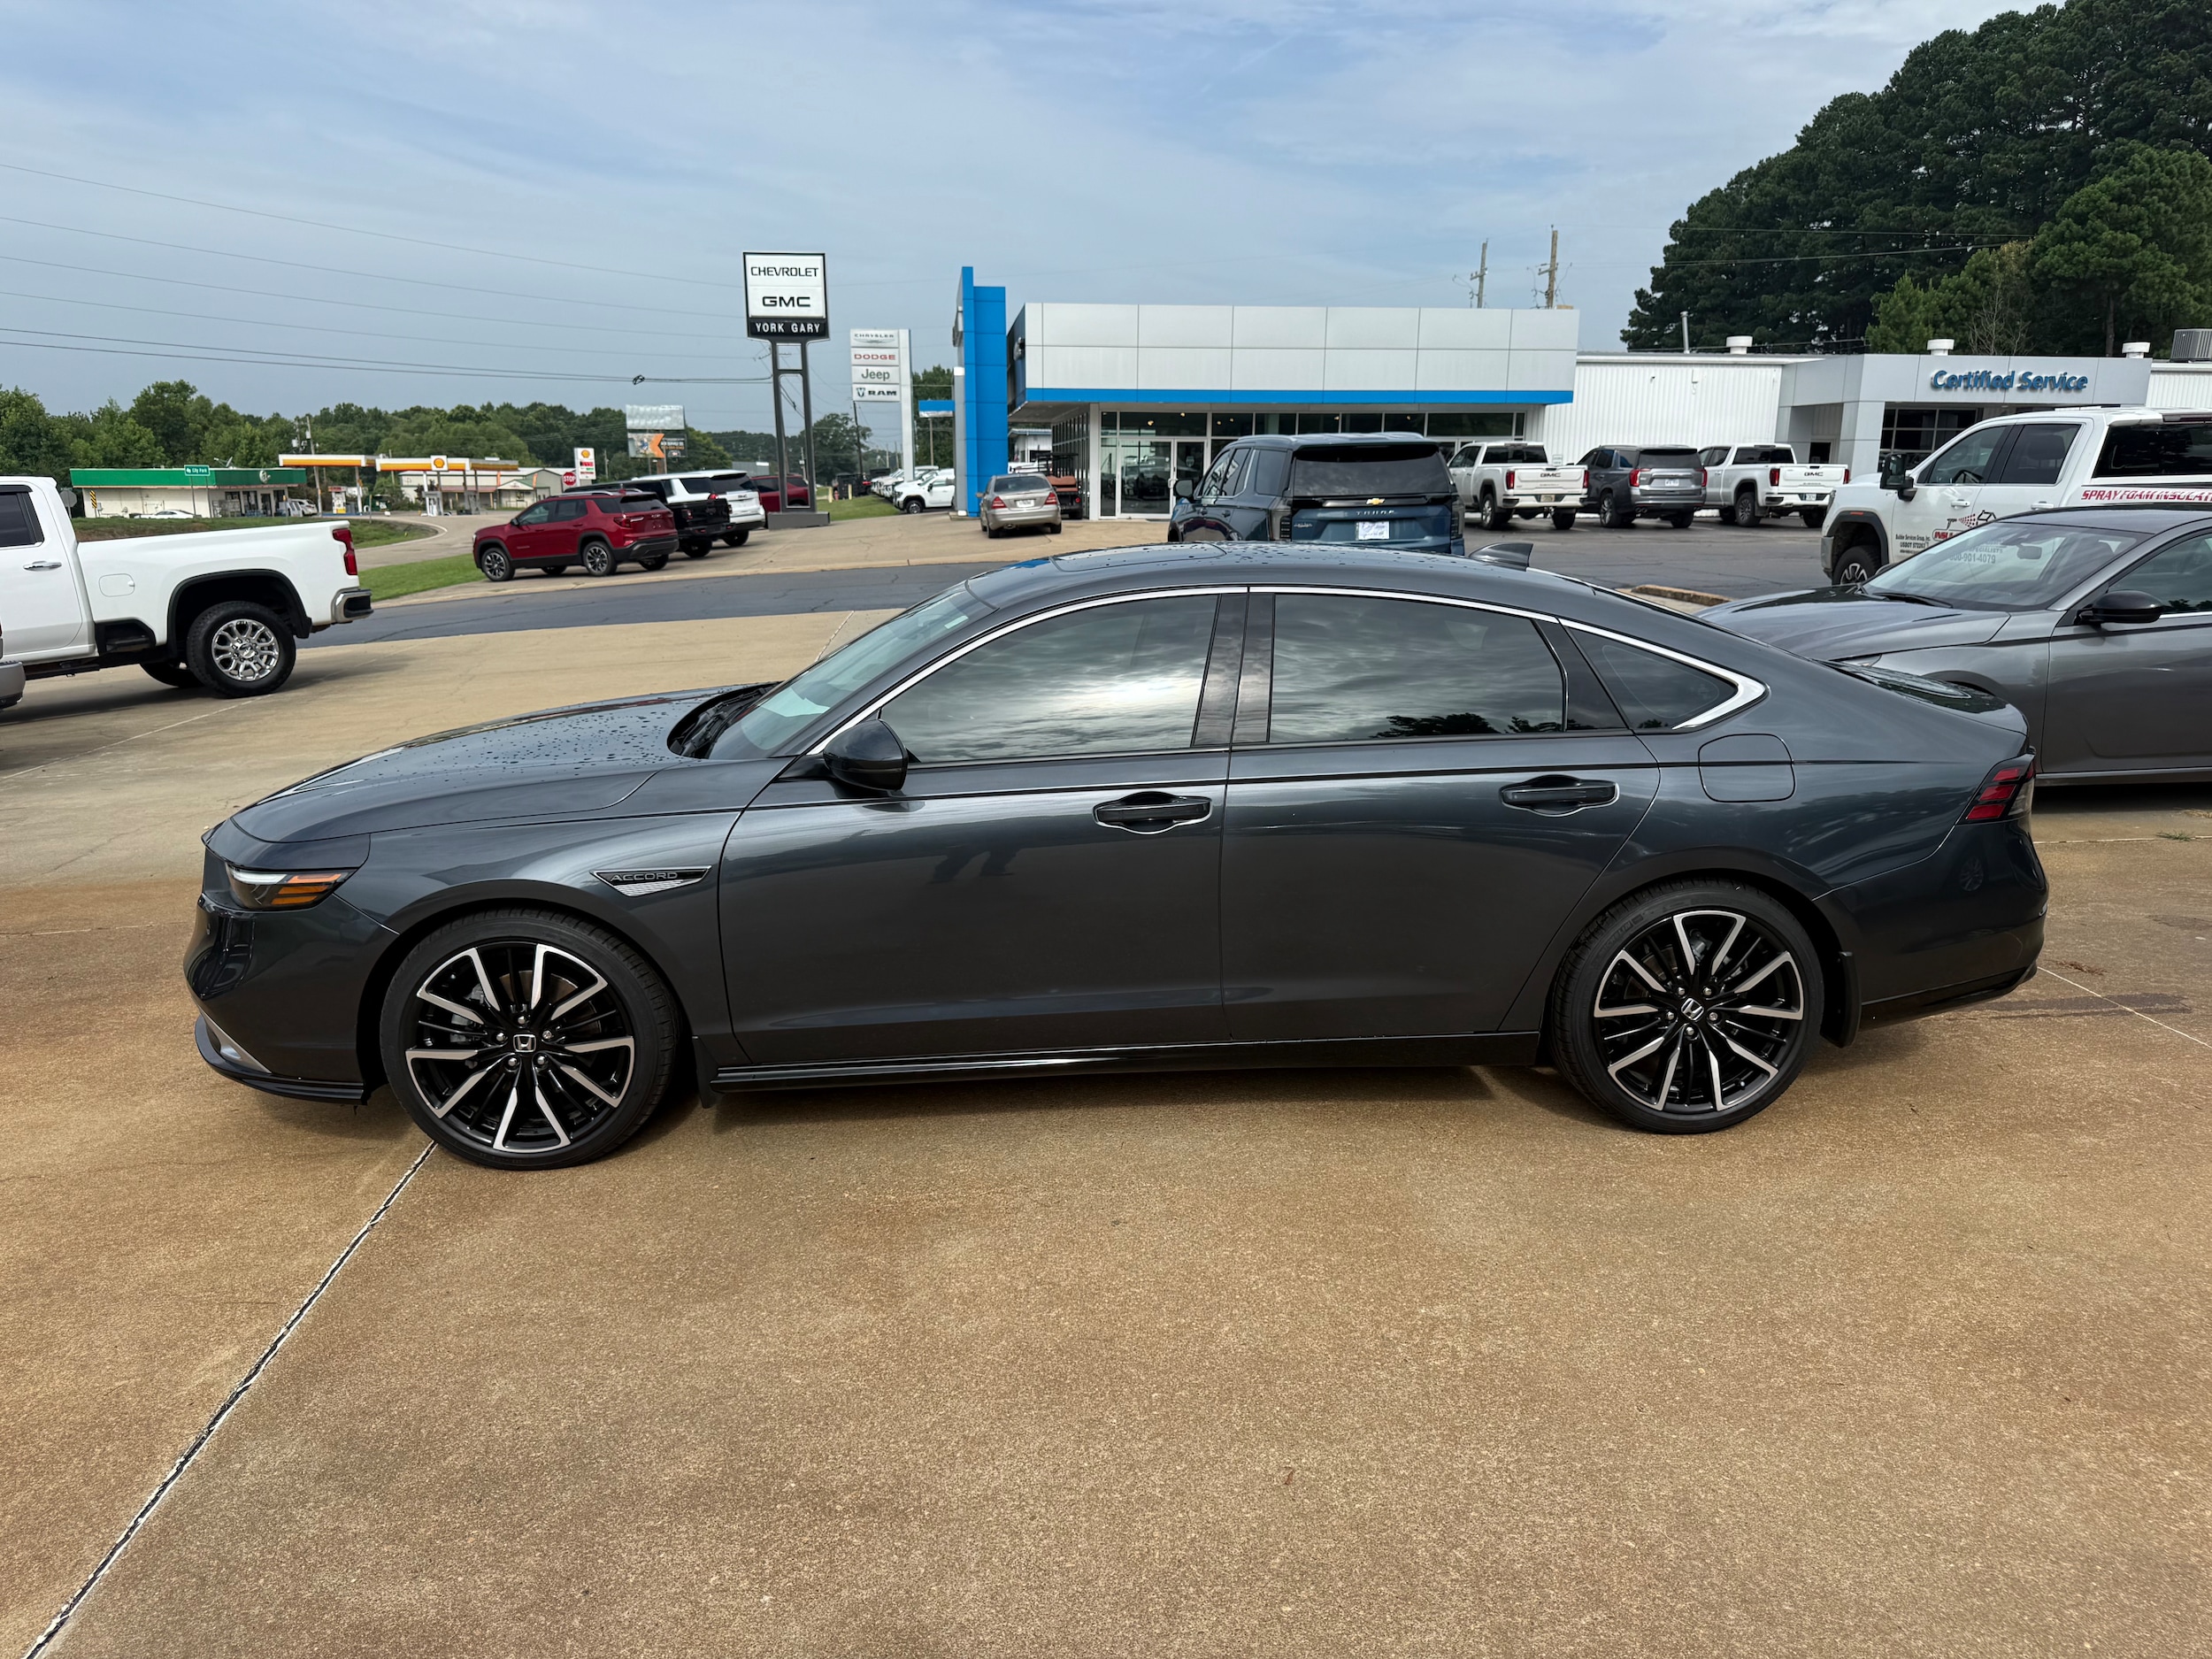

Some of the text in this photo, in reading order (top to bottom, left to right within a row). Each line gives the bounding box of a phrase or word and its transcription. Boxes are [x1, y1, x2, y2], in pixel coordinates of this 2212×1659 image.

[750, 266, 819, 277] CHEVROLET
[762, 296, 811, 308] GMC
[756, 323, 821, 334] YORK GARY
[861, 368, 891, 381] Jeep
[1932, 370, 2088, 390] Certified Service
[2081, 489, 2122, 501] SPRAY
[611, 872, 679, 882] ACCORD
